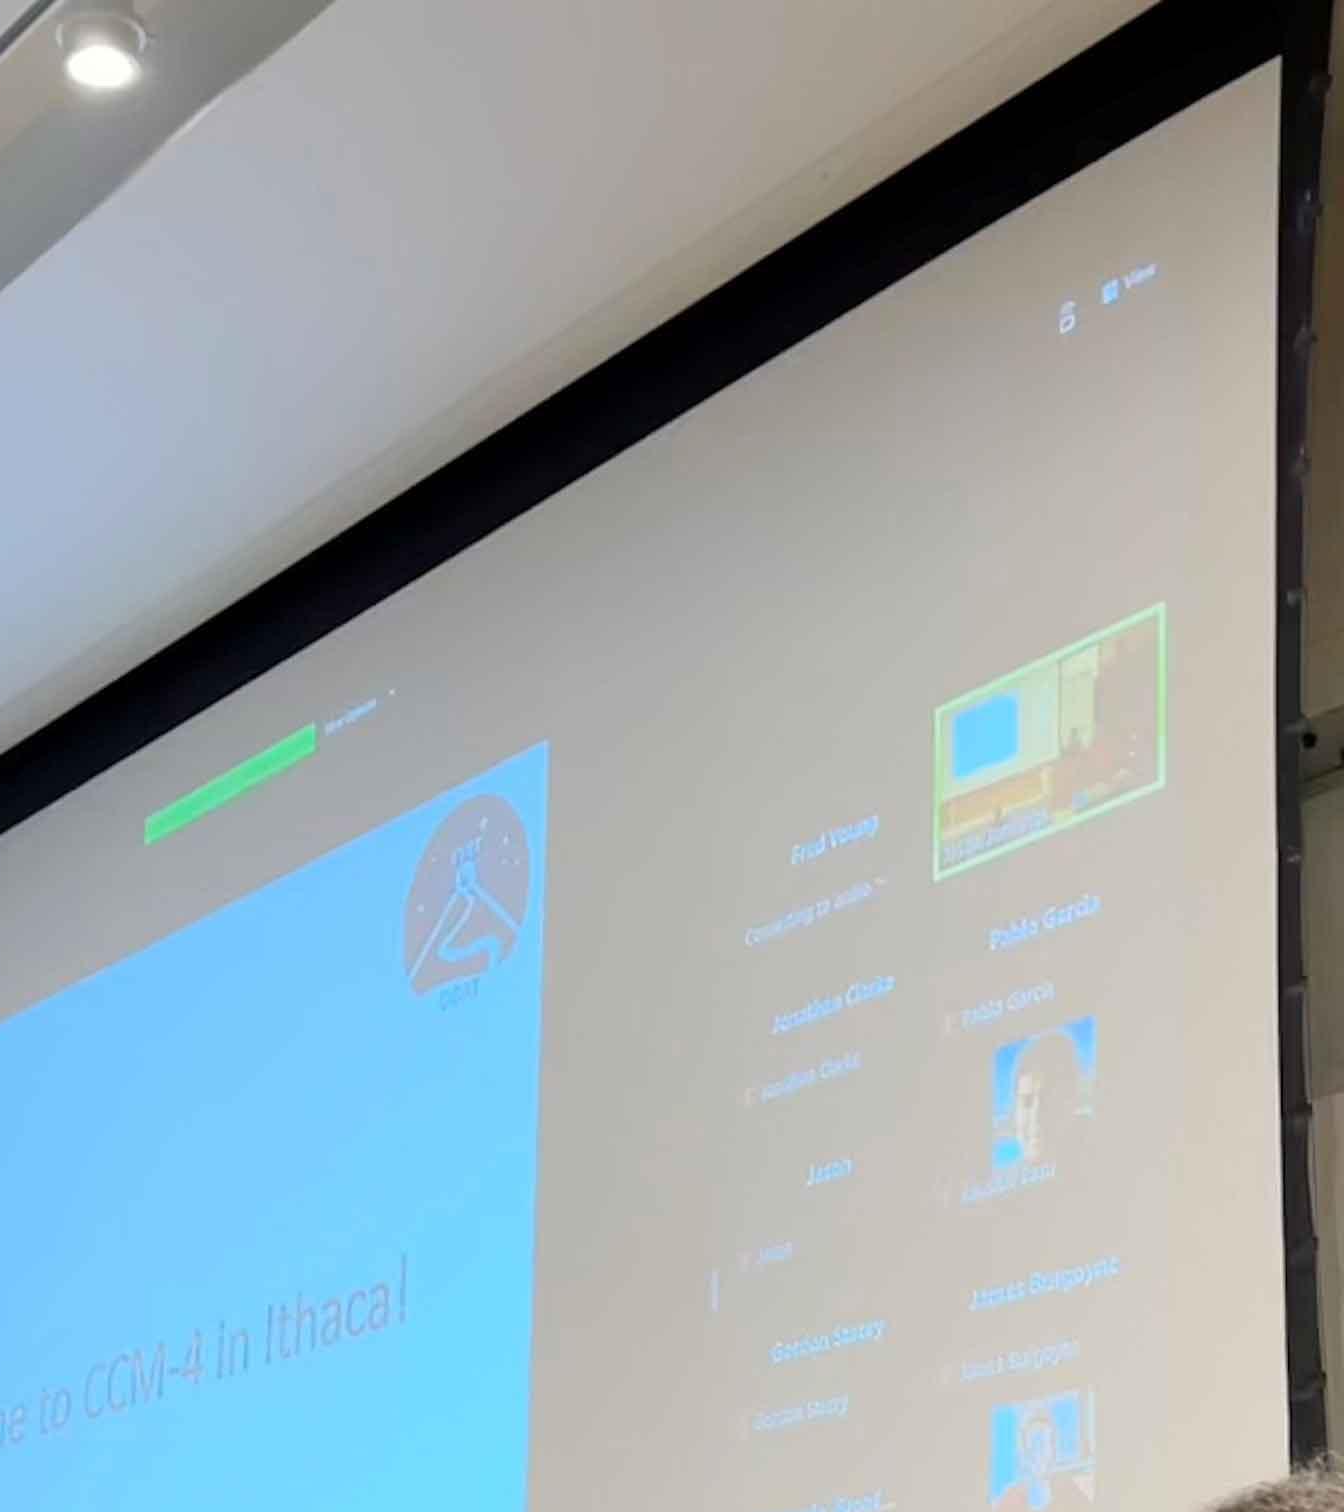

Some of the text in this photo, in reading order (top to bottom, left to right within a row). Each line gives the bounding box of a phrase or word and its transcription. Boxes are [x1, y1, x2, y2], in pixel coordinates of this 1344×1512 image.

[39, 1385, 72, 1437] to
[82, 1329, 204, 1421] CCM-4
[216, 1319, 250, 1381] in
[264, 1252, 409, 1366] Ithaca!
